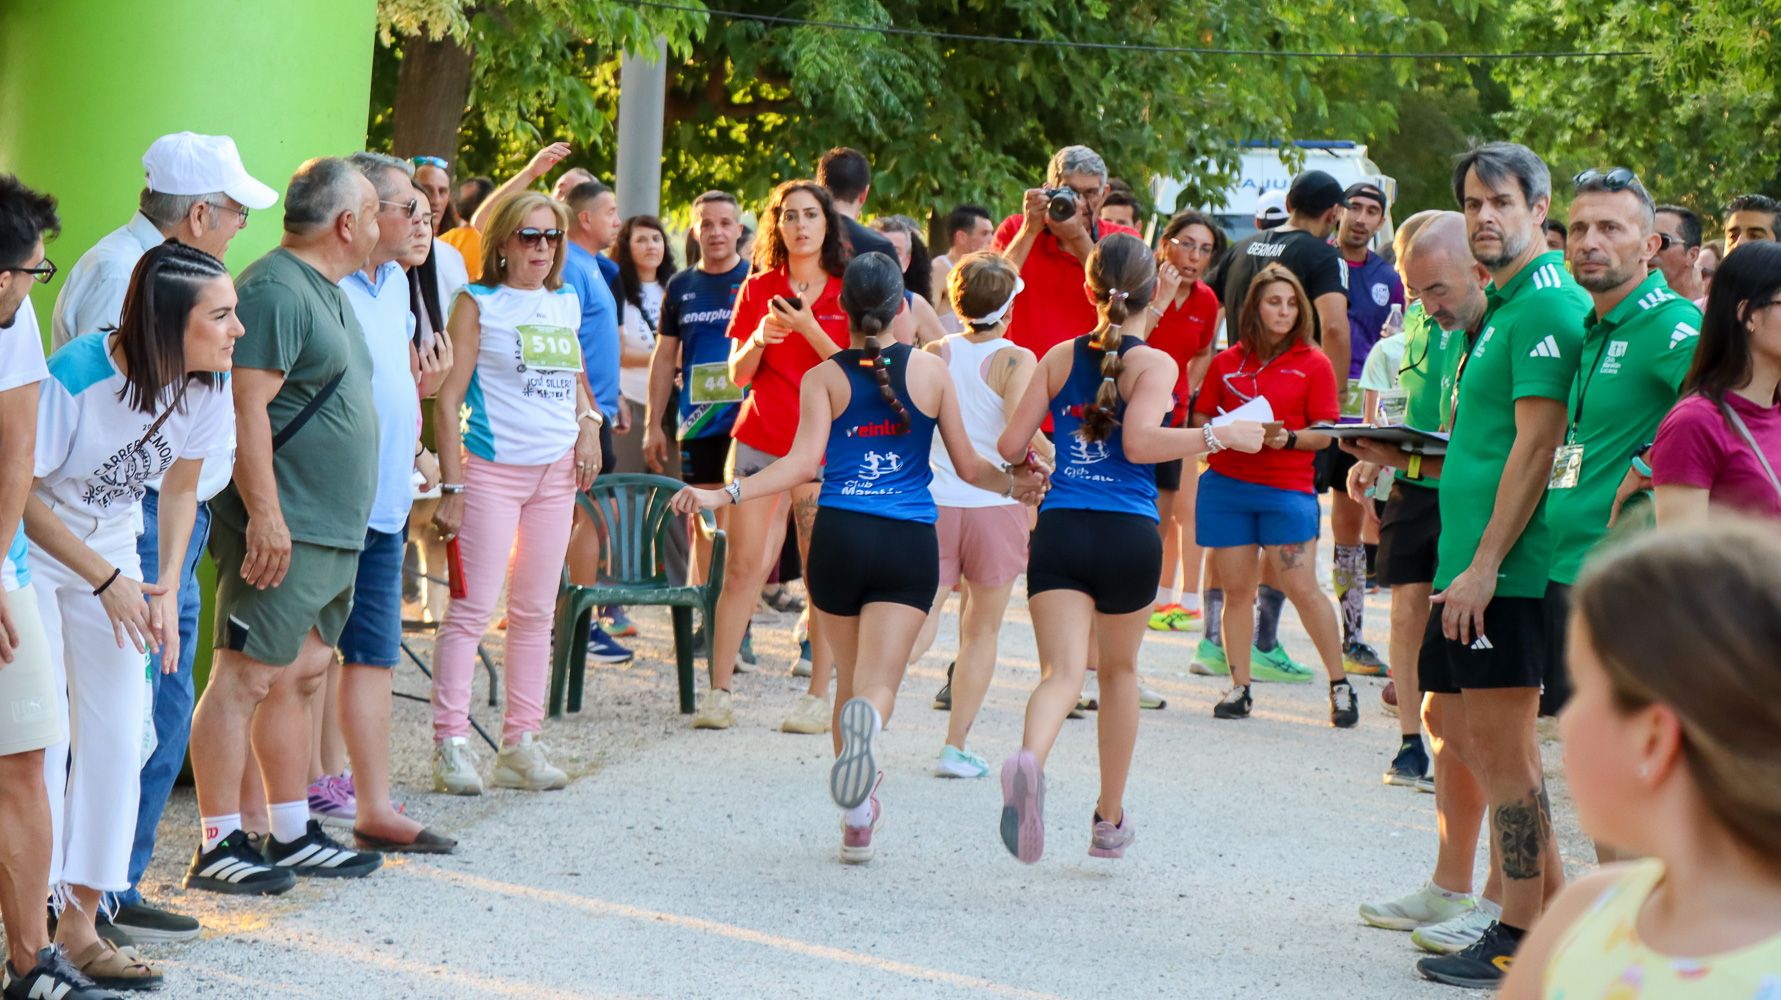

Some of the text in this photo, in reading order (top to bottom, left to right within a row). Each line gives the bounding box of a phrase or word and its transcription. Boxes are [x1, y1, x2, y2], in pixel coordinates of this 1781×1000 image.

[1247, 242, 1286, 257] GERMAN
[682, 308, 734, 324] enerplu
[532, 335, 572, 355] 510
[844, 479, 873, 489] Club
